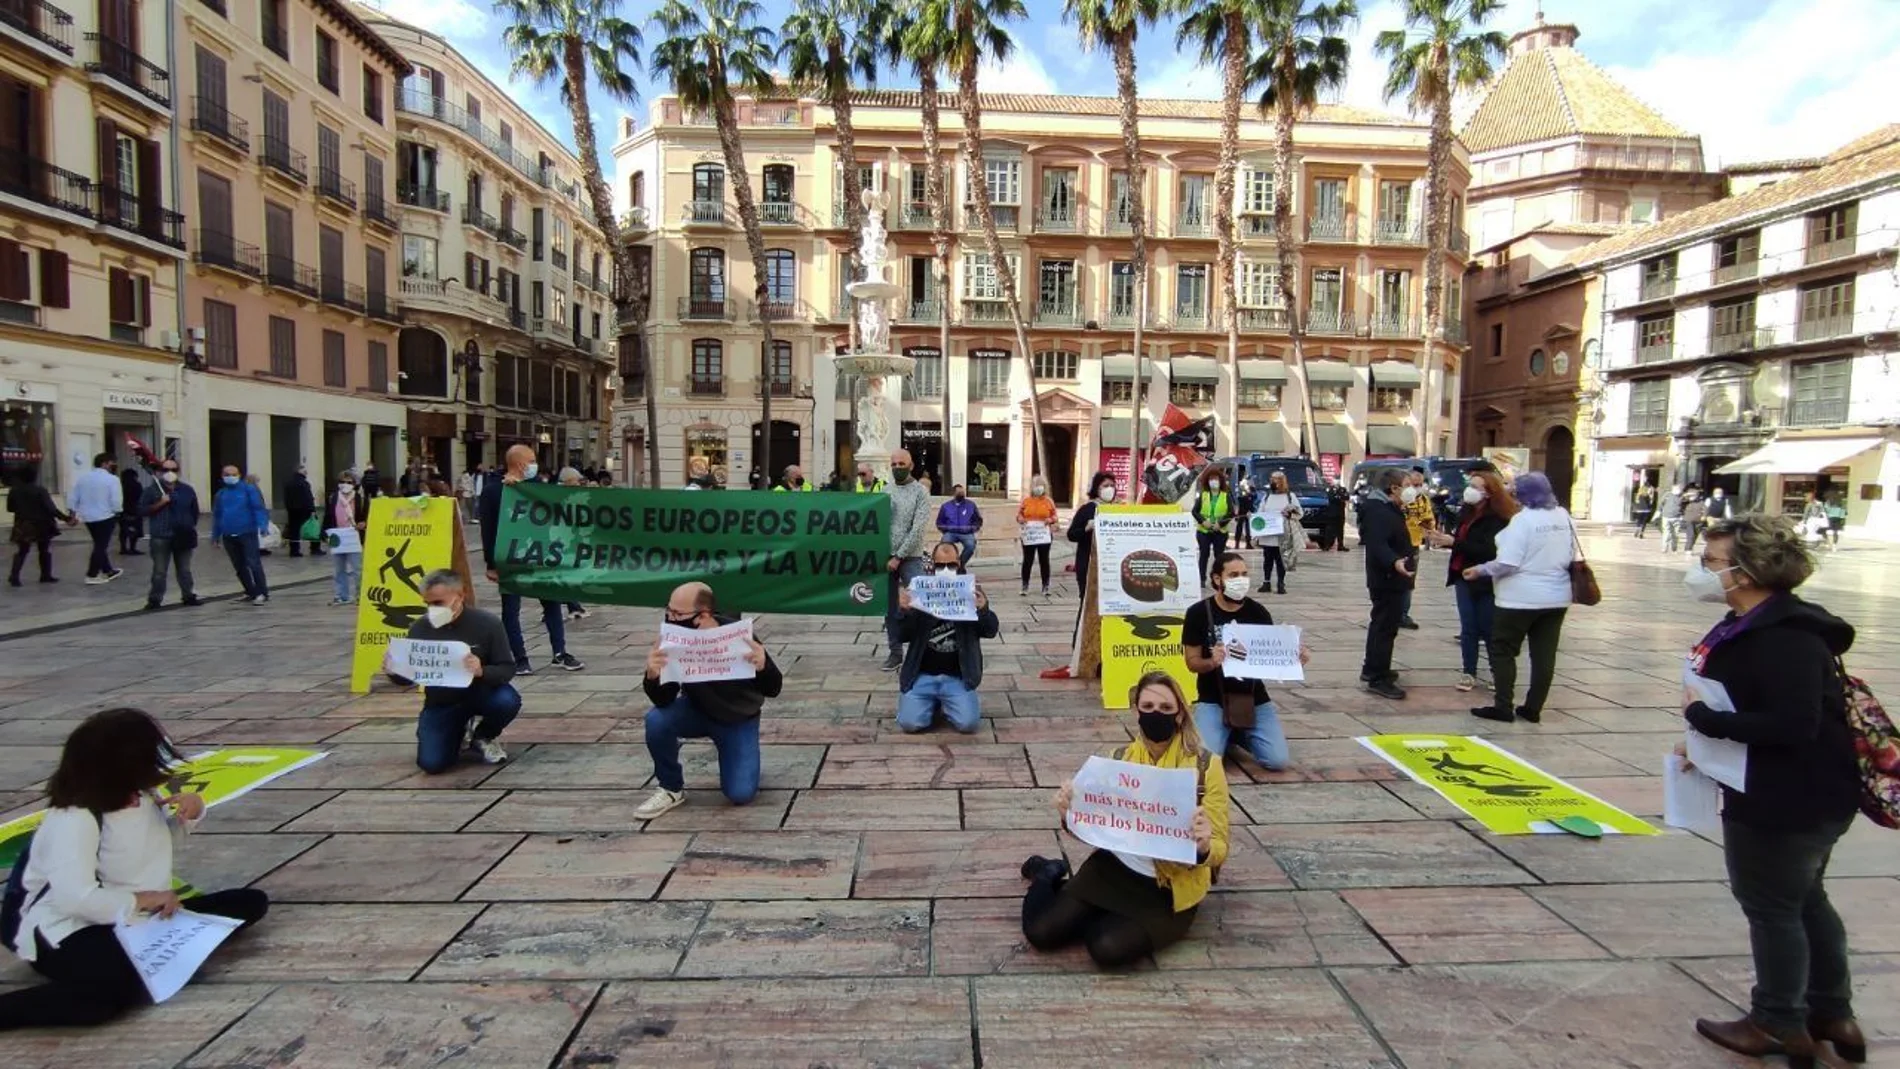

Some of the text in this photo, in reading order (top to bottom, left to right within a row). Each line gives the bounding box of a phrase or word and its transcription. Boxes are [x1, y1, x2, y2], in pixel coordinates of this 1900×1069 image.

[109, 394, 153, 406] EL GANSO
[510, 499, 880, 536] FONDOS EUROPEOS PARA
[384, 523, 432, 537] ¡CUIDADO!
[507, 538, 879, 576] LAS PERSONAS Y LA VIDA
[411, 642, 450, 655] Renta
[1112, 644, 1184, 659] GREENWASHIN
[414, 670, 443, 681] para
[1118, 772, 1141, 789] No
[1084, 790, 1178, 817] más rescates
[1073, 810, 1191, 840] para los bancos
